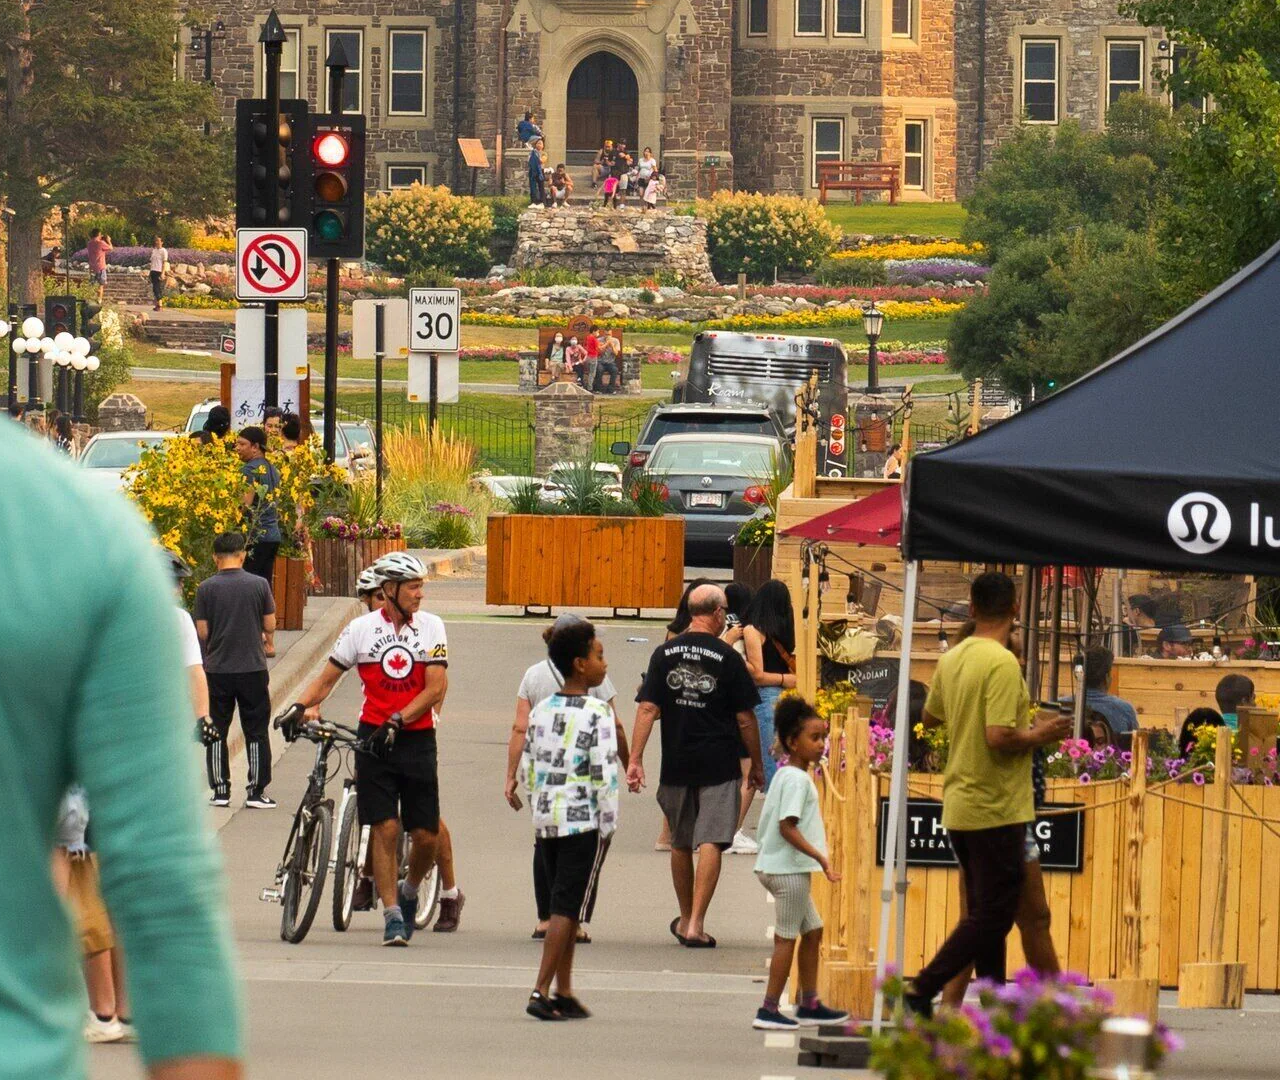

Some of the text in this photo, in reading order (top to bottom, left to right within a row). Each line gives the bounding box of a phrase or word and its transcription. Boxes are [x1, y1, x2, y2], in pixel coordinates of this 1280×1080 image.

[415, 295, 455, 306] MAXIMUM
[416, 312, 453, 340] 30
[433, 643, 447, 658] 25
[664, 645, 724, 662] HARLEY-DAVIDSON
